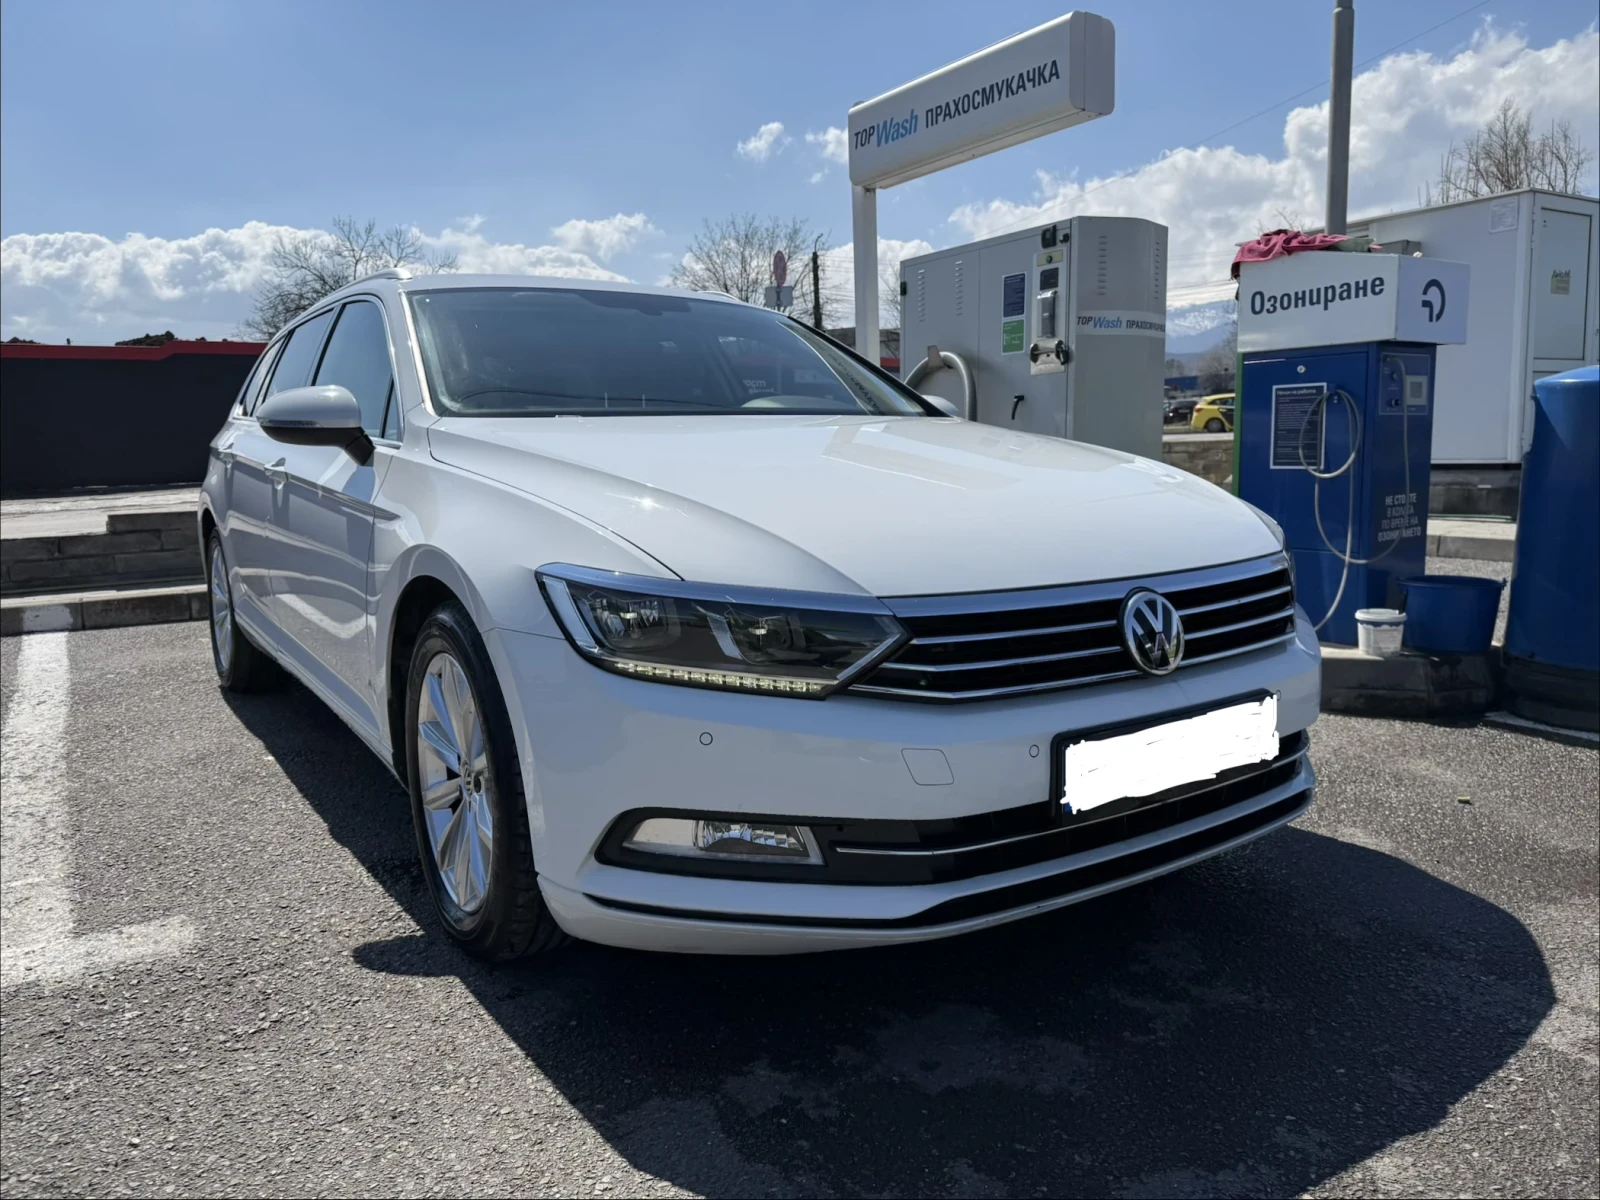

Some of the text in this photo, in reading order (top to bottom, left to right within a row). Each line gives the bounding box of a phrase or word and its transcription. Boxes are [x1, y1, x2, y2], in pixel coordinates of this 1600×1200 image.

[925, 59, 1060, 129] ПРАХОСМУКАЧКА
[1250, 276, 1385, 315] Озониране
[1385, 492, 1417, 506] НЕ СТОТЕ
[1391, 516, 1409, 528] ВРЕЕ
[1378, 526, 1421, 542] ОЗОНИАНЕТО
